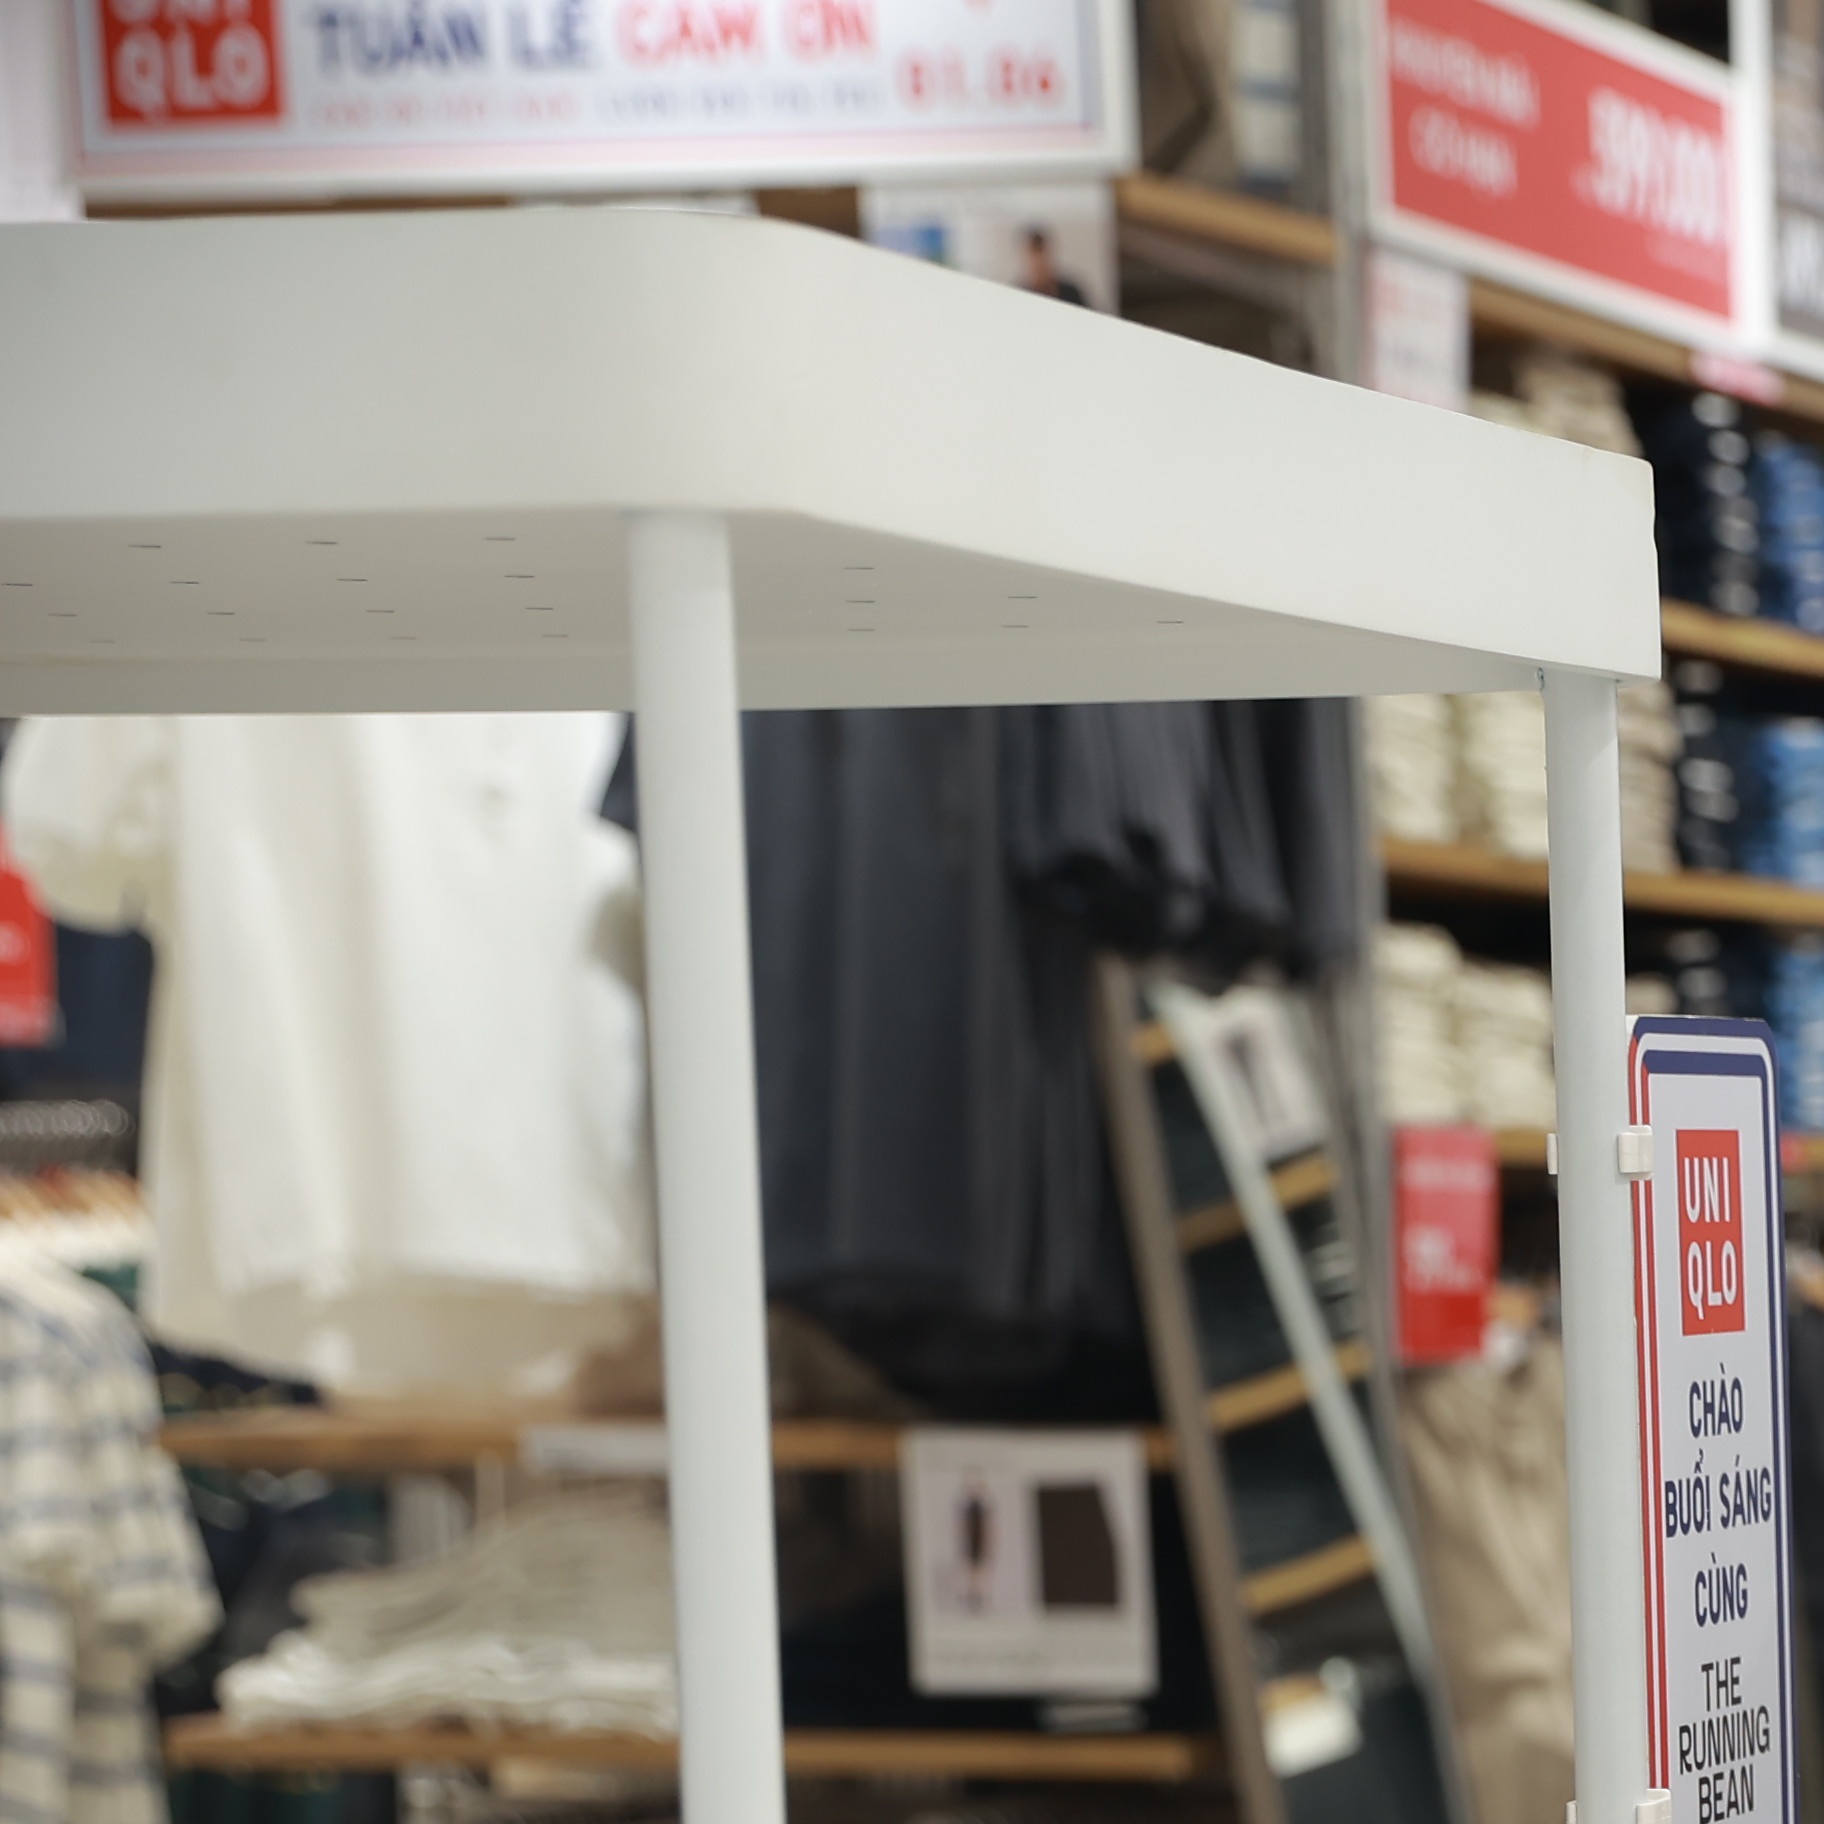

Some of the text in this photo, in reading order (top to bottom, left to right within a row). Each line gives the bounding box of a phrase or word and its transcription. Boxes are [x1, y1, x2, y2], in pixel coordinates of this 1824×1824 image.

[1683, 1157, 1731, 1223] UNI
[1687, 1240, 1737, 1320] QLO
[1689, 1362, 1743, 1438] CHÀO
[1664, 1448, 1772, 1537] BUỔI SÁNG
[1694, 1552, 1748, 1628] CÙNG
[1701, 1656, 1742, 1712] THE
[1678, 1705, 1770, 1775] RUNNING
